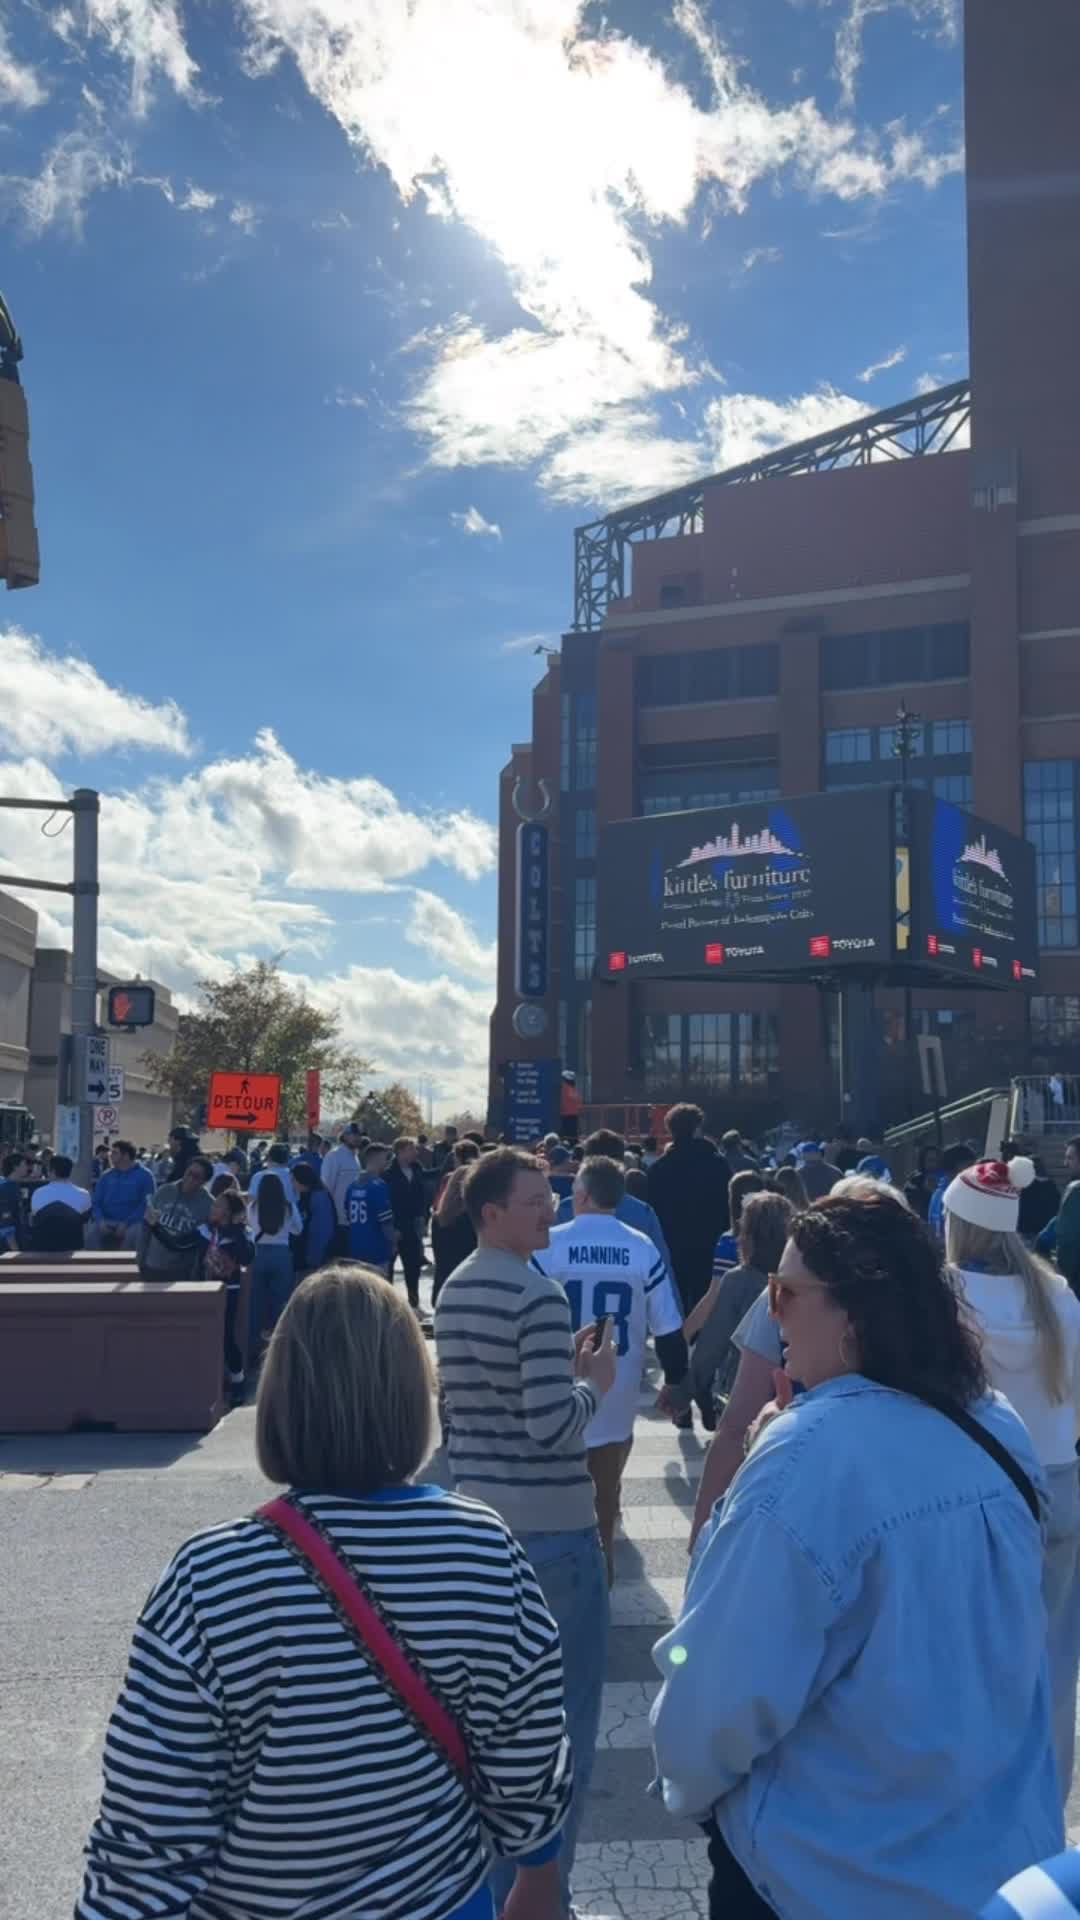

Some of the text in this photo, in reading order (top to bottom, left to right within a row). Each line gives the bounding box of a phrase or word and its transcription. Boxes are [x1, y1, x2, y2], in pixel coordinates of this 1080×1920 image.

[723, 865, 811, 890] furniture
[213, 1094, 274, 1111] DETOUR
[568, 1245, 631, 1267] MANNING
